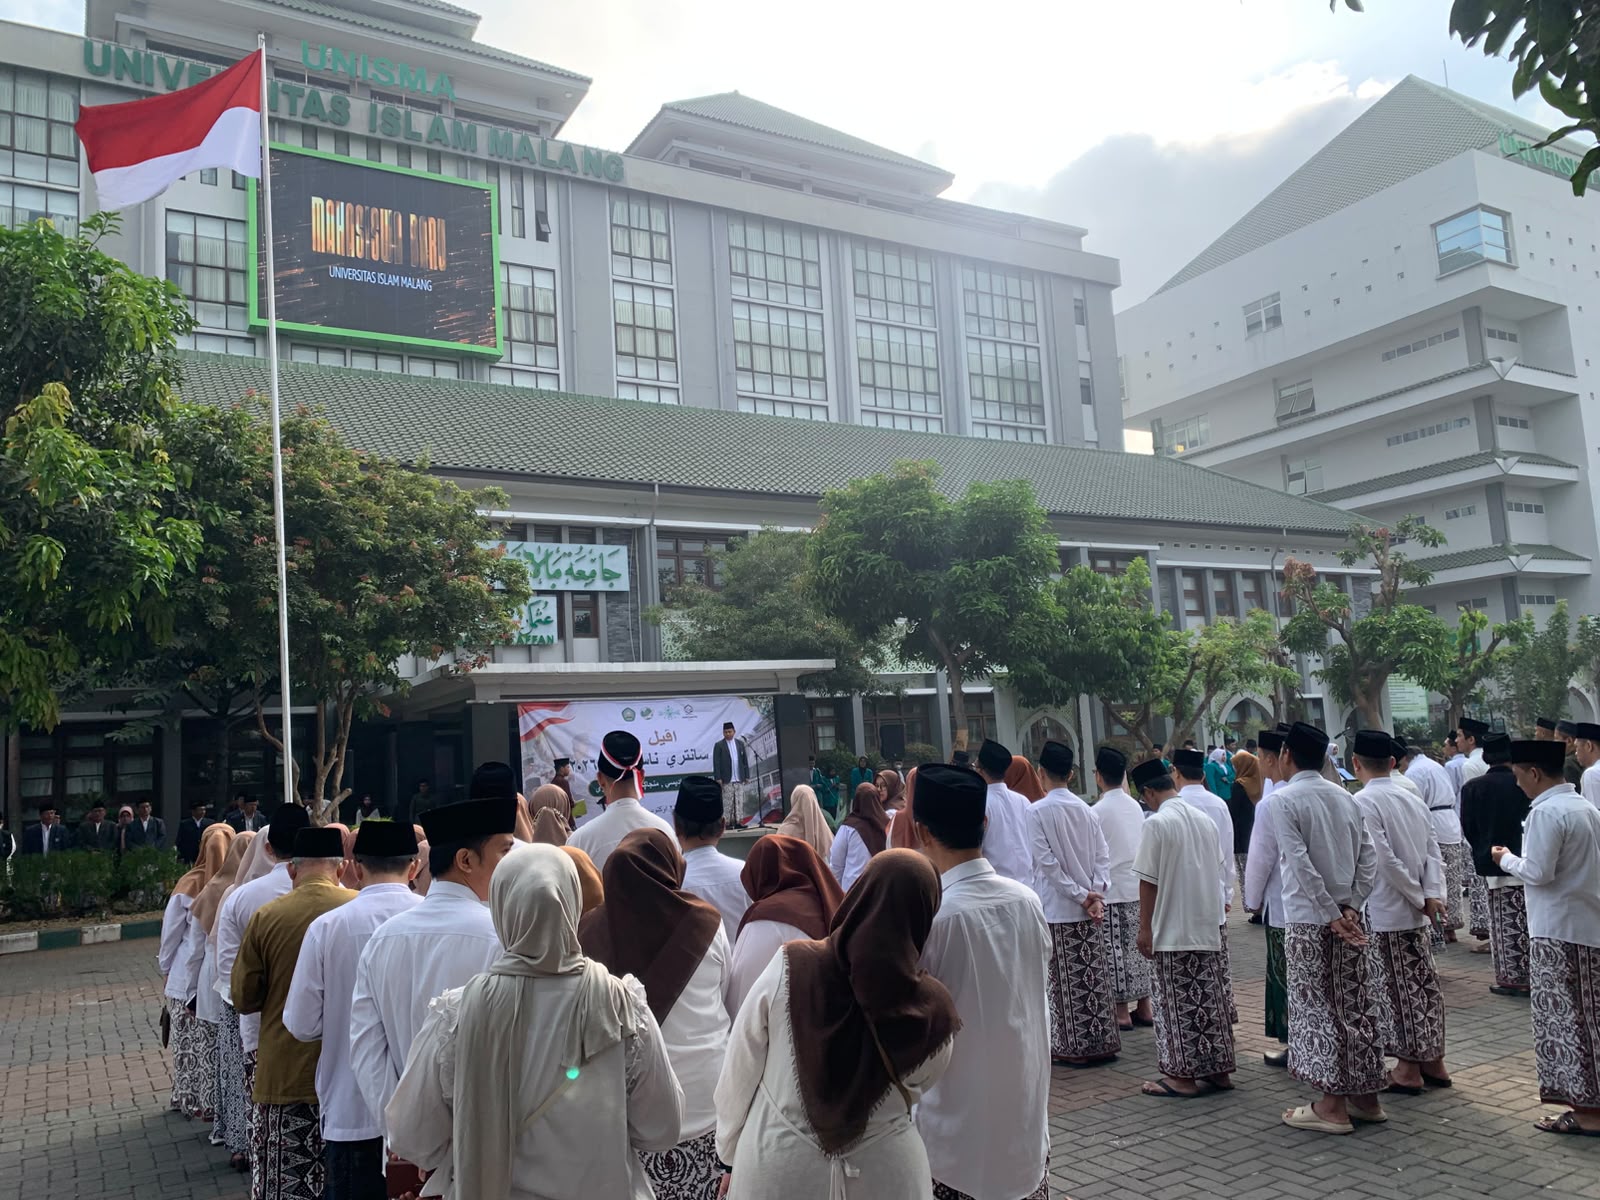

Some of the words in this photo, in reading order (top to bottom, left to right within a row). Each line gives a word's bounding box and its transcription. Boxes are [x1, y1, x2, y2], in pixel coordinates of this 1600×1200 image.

[301, 40, 457, 101] UNISMA
[84, 38, 350, 127] UNIVEITAS
[368, 101, 478, 154] ISLAM
[488, 125, 625, 182] MALANG
[328, 264, 377, 285] UNIVERSITAS
[377, 272, 400, 290] ISLAM
[400, 275, 433, 292] MALANG
